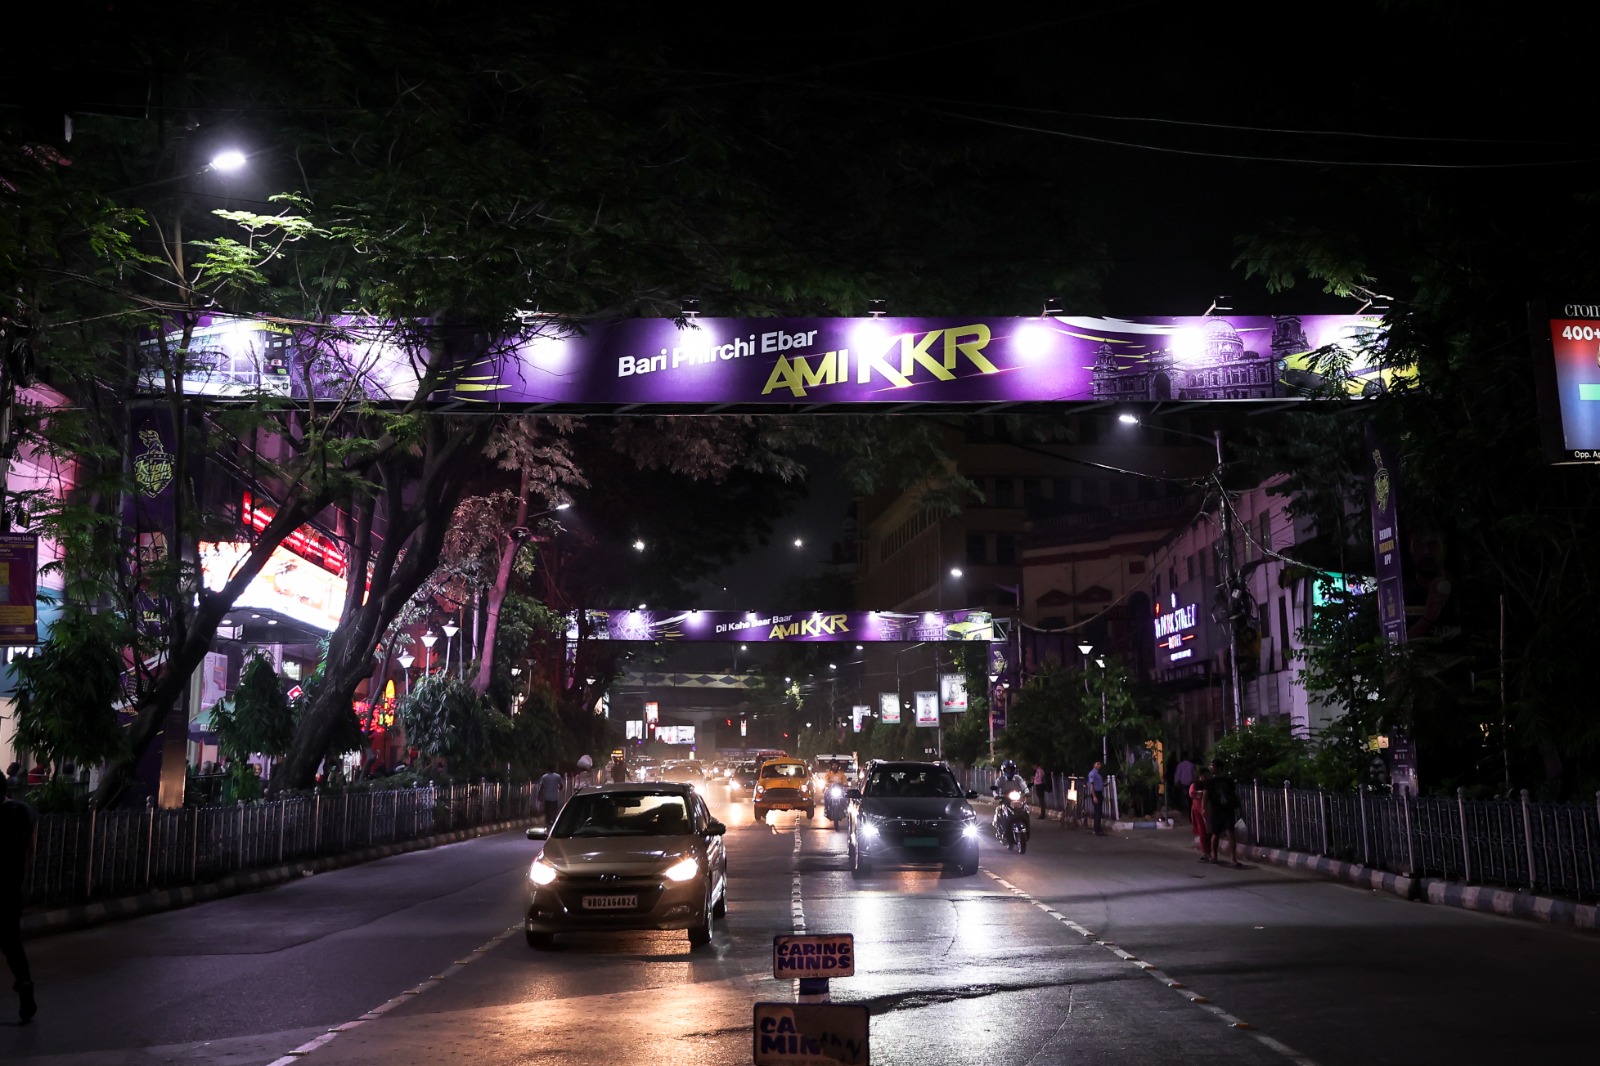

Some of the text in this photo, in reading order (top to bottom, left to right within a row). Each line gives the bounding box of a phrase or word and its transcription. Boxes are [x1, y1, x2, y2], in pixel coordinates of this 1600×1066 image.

[618, 349, 667, 377] Bari
[761, 329, 818, 353] Ebar
[761, 323, 1000, 397] AMI KKR
[1574, 450, 1592, 460] Opp.
[716, 623, 727, 634] Dil
[728, 621, 751, 631] Kahe
[772, 614, 793, 624] Baar
[768, 613, 850, 639] AMI KKR
[777, 942, 851, 957] CARING
[777, 955, 851, 971] MINDS
